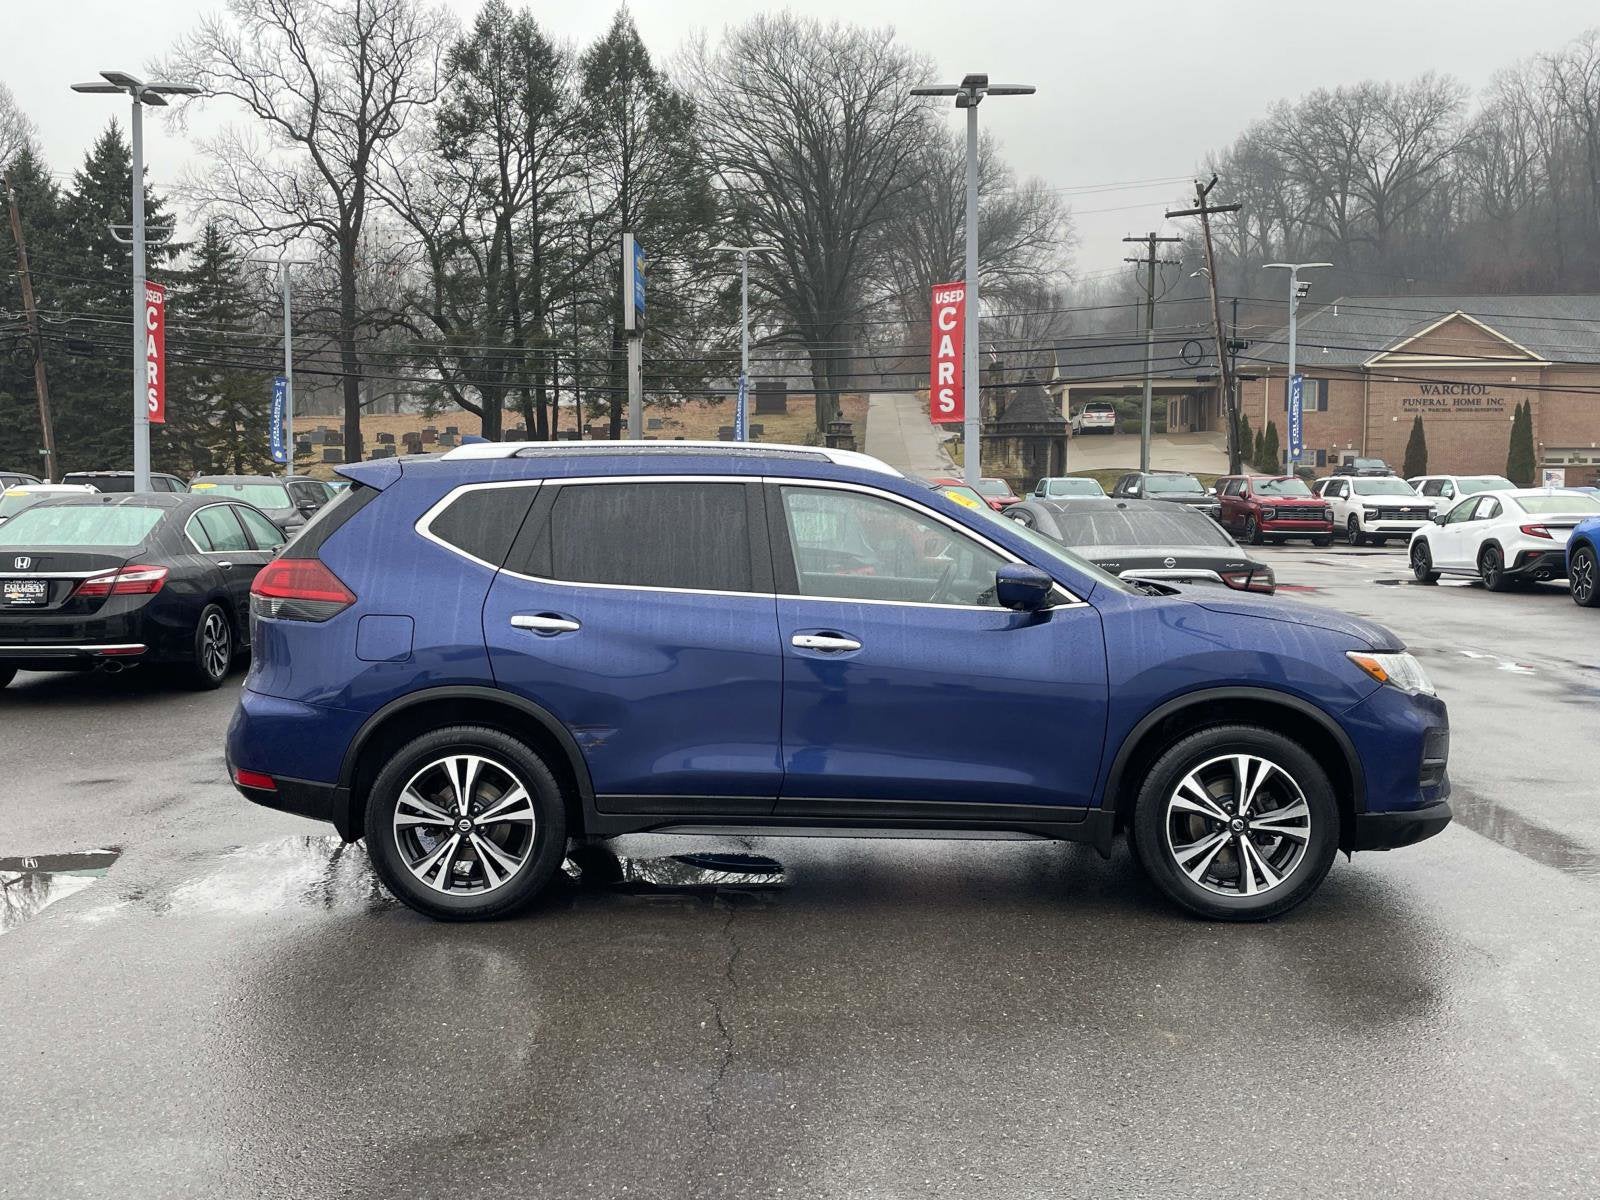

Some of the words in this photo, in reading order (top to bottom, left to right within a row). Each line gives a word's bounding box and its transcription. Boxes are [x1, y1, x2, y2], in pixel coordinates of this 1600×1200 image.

[935, 290, 964, 304] USED
[146, 306, 158, 412] CARS
[938, 307, 957, 412] CARS
[1420, 384, 1490, 395] WARCHOL
[1402, 398, 1448, 406] FUNERAL
[1453, 398, 1482, 406] HOME
